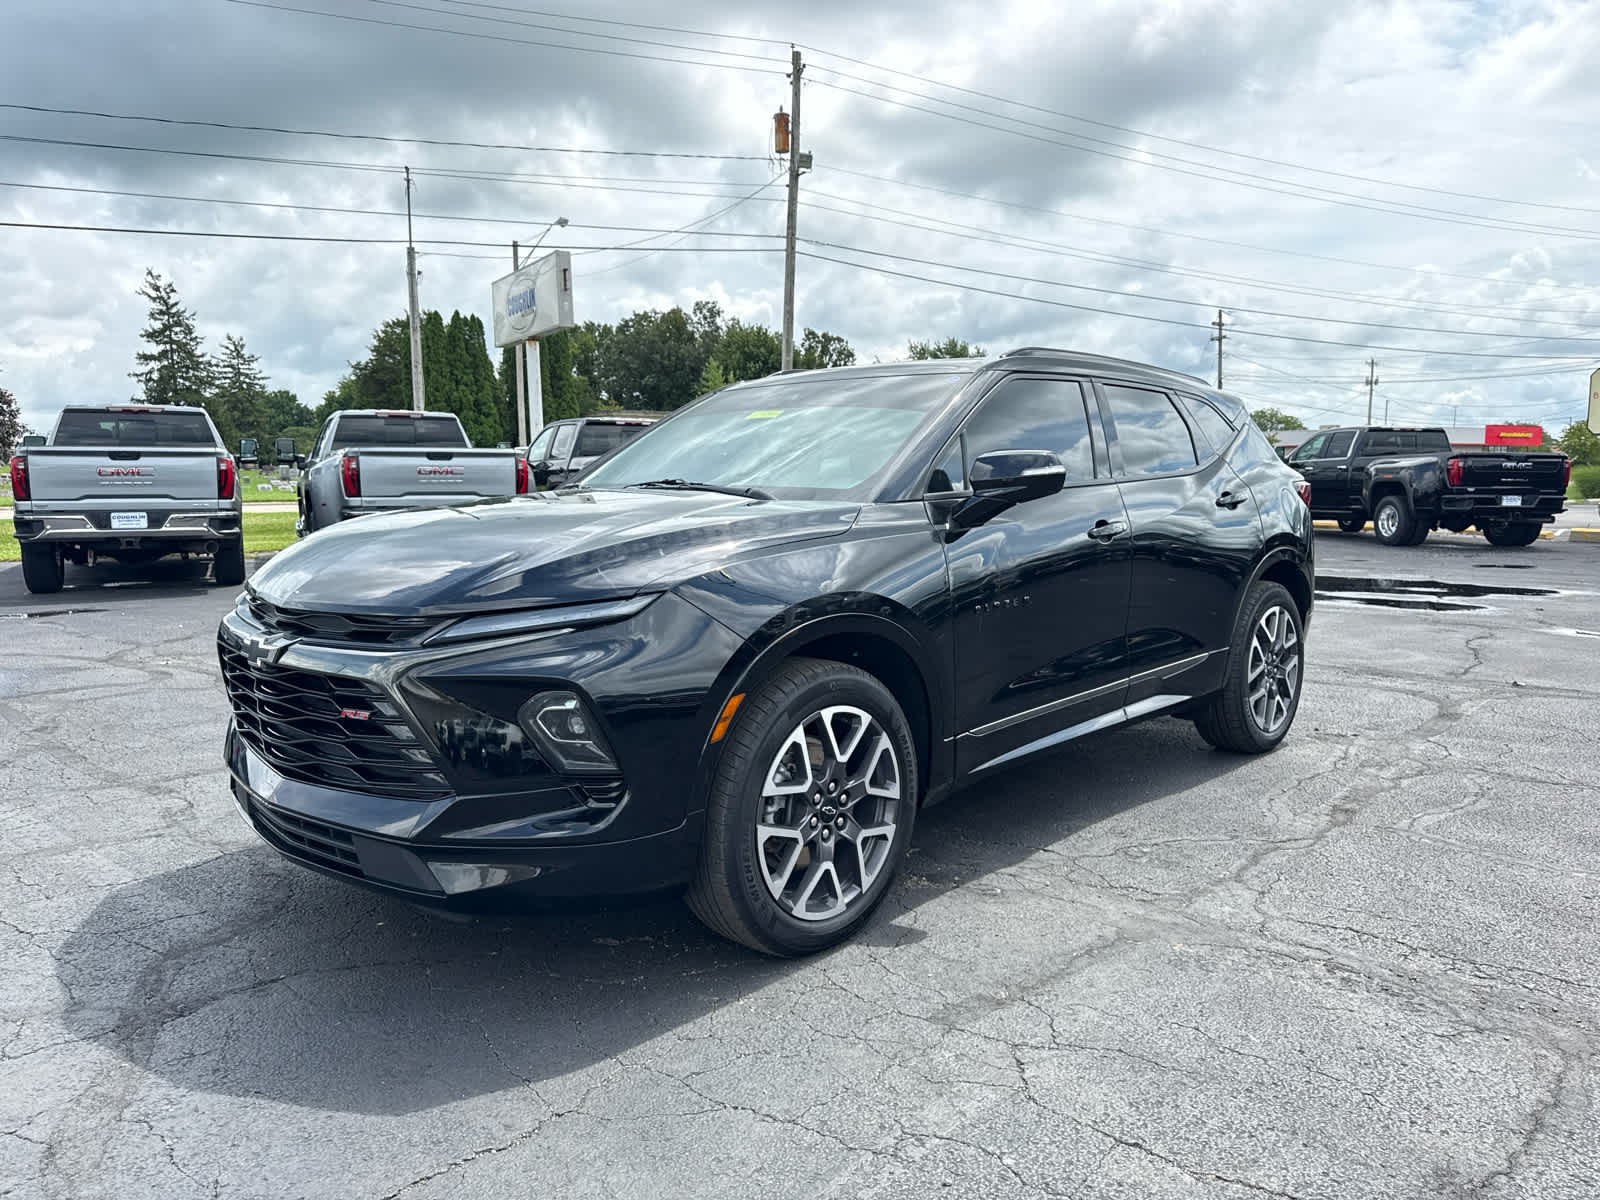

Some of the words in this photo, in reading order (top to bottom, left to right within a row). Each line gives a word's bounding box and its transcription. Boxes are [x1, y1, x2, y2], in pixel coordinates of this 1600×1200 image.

[97, 466, 155, 477] GMC
[416, 466, 464, 476] GMC
[341, 709, 370, 720] RS
